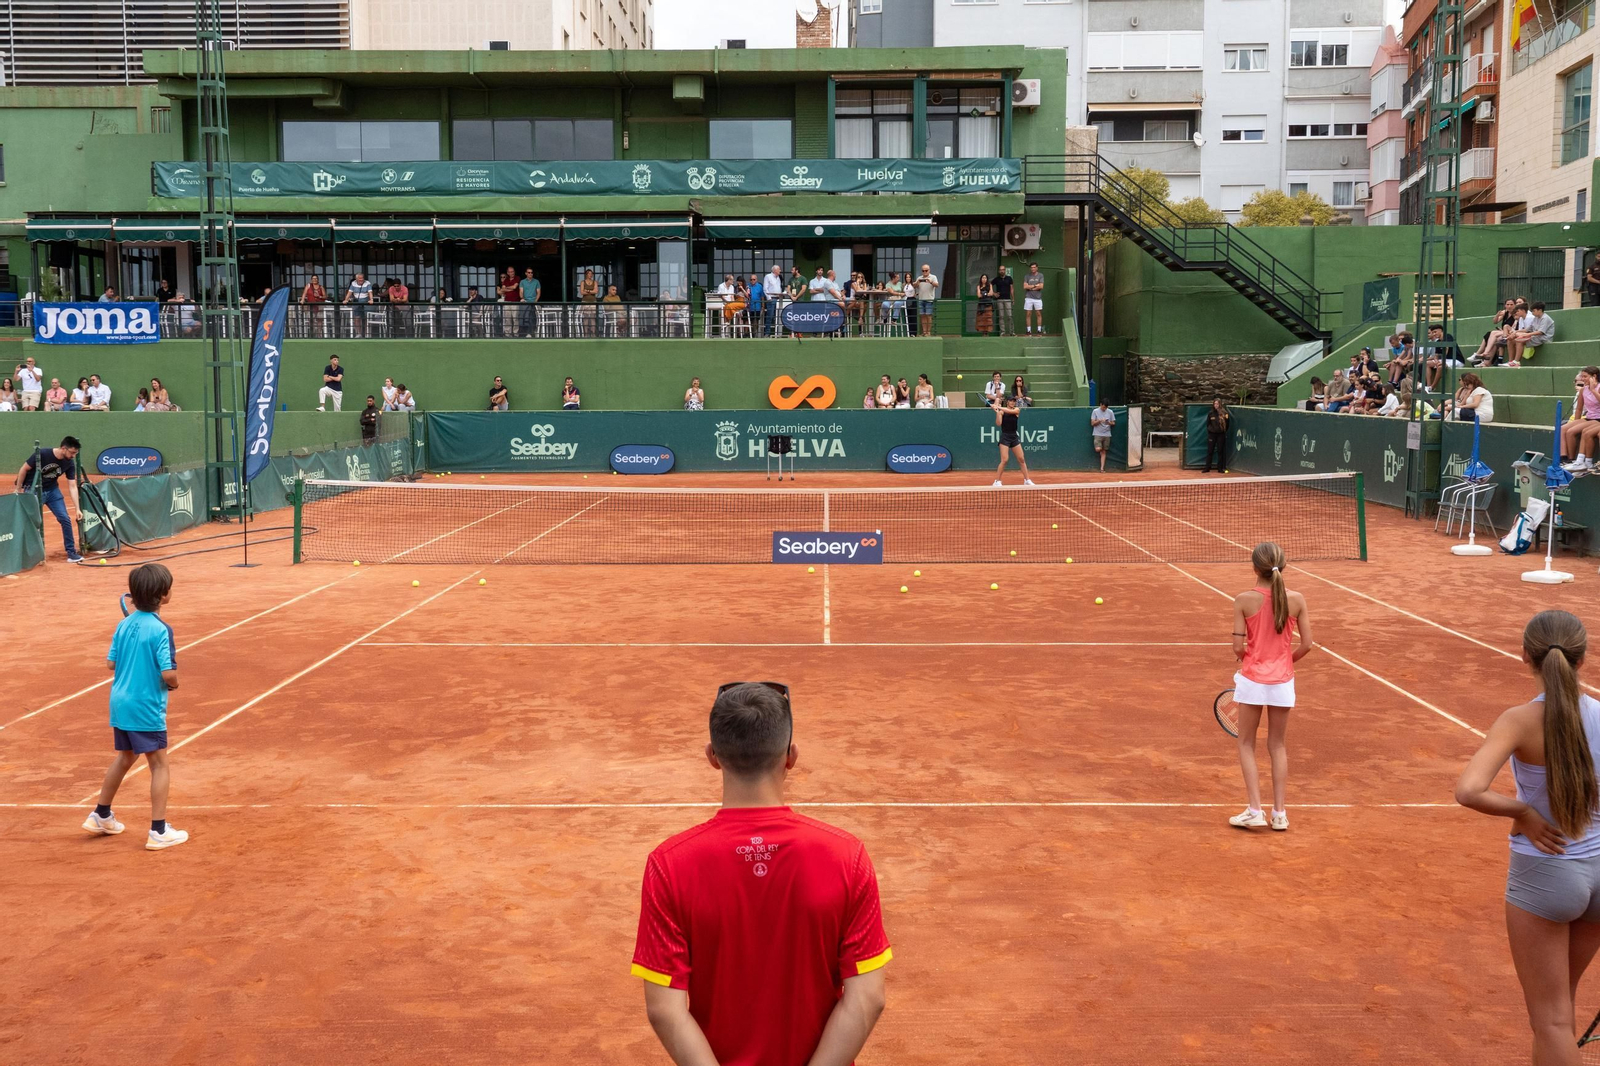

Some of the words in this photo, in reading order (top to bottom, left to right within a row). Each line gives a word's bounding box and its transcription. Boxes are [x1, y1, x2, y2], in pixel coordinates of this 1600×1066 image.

[550, 172, 596, 184] Andalucía
[857, 168, 903, 180] Huelva
[780, 174, 823, 189] Seabery
[959, 175, 1009, 186] HUELVA
[786, 311, 830, 324] Seabery
[747, 423, 826, 436] Ayuntamiento
[828, 423, 843, 434] de
[510, 437, 578, 460] Seabery
[1024, 444, 1048, 453] original
[101, 455, 148, 467] Seabery
[614, 453, 660, 466] Seabery
[891, 453, 937, 465] Seabery
[778, 537, 859, 559] Seabery
[736, 846, 755, 855] COPA
[757, 845, 766, 853] DEL
[768, 844, 779, 852] REY
[745, 853, 753, 862] DE
[754, 852, 772, 861] TENIS
